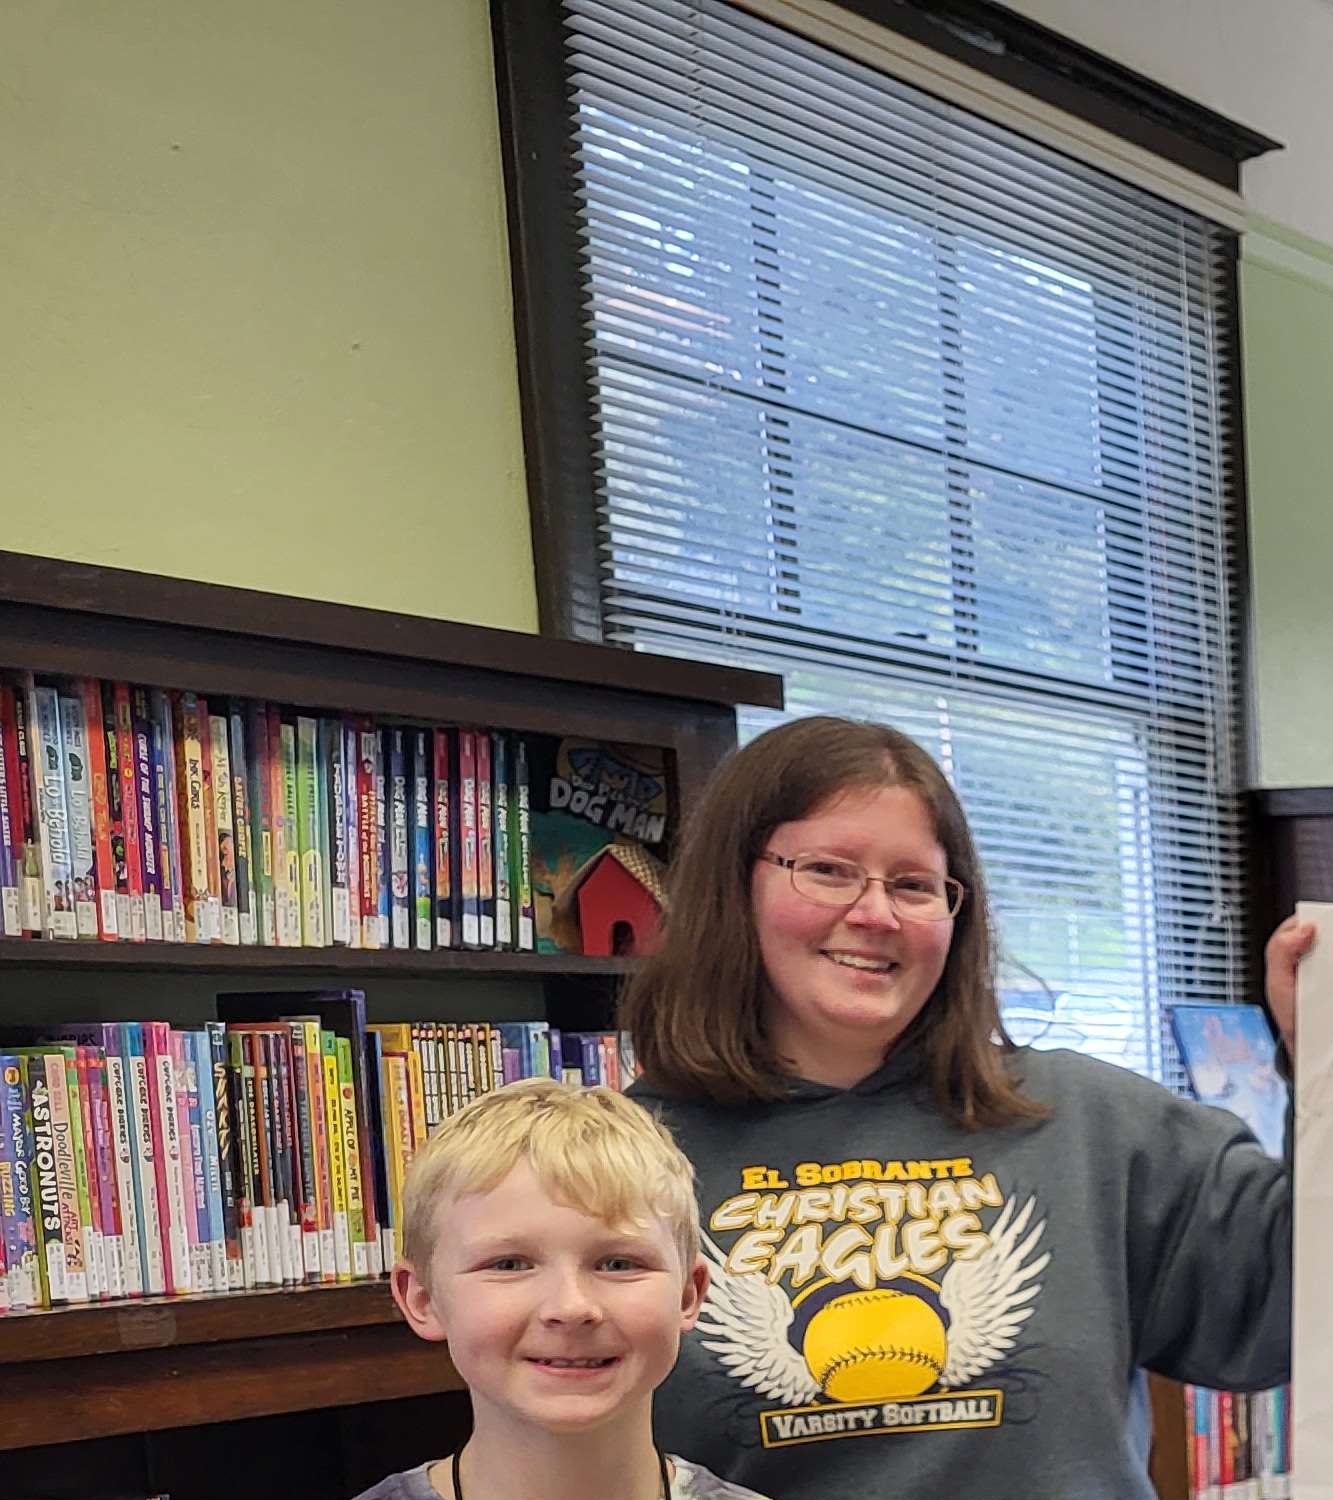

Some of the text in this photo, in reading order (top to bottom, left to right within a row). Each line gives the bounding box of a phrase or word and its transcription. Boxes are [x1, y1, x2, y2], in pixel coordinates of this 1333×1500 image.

[48, 809, 69, 865] Behold
[550, 778, 665, 842] DOG MAN
[12, 1114, 25, 1157] MAYOR
[32, 1093, 60, 1230] ASTRONUTS
[53, 1123, 75, 1199] Doodleville
[15, 1161, 29, 1194] GOOD
[742, 1157, 974, 1190] EL SOBRANTE
[710, 1173, 1004, 1232] CHRISTIAN
[725, 1212, 993, 1289] EAGLES
[771, 1399, 994, 1439] VARSITY SOFTBALL
